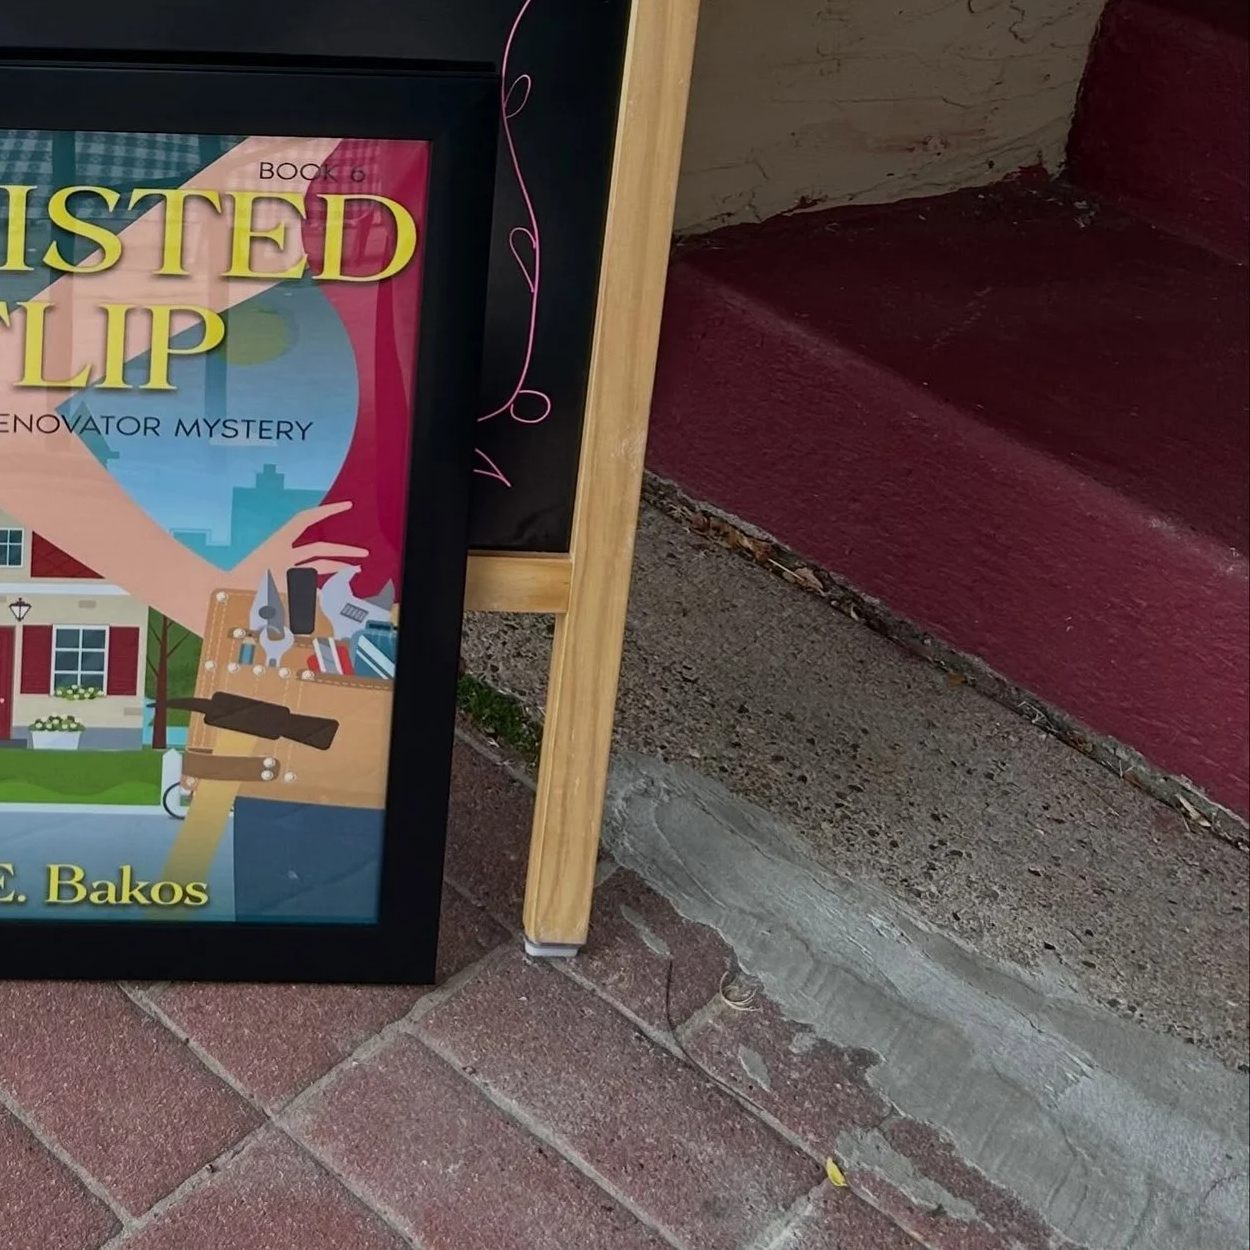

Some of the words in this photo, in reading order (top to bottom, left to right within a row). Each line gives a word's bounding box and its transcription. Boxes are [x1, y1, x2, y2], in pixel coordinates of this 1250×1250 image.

[259, 161, 338, 182] BOOK
[350, 165, 367, 183] 6
[174, 417, 315, 442] MYSTERY
[45, 863, 209, 907] Bakos
